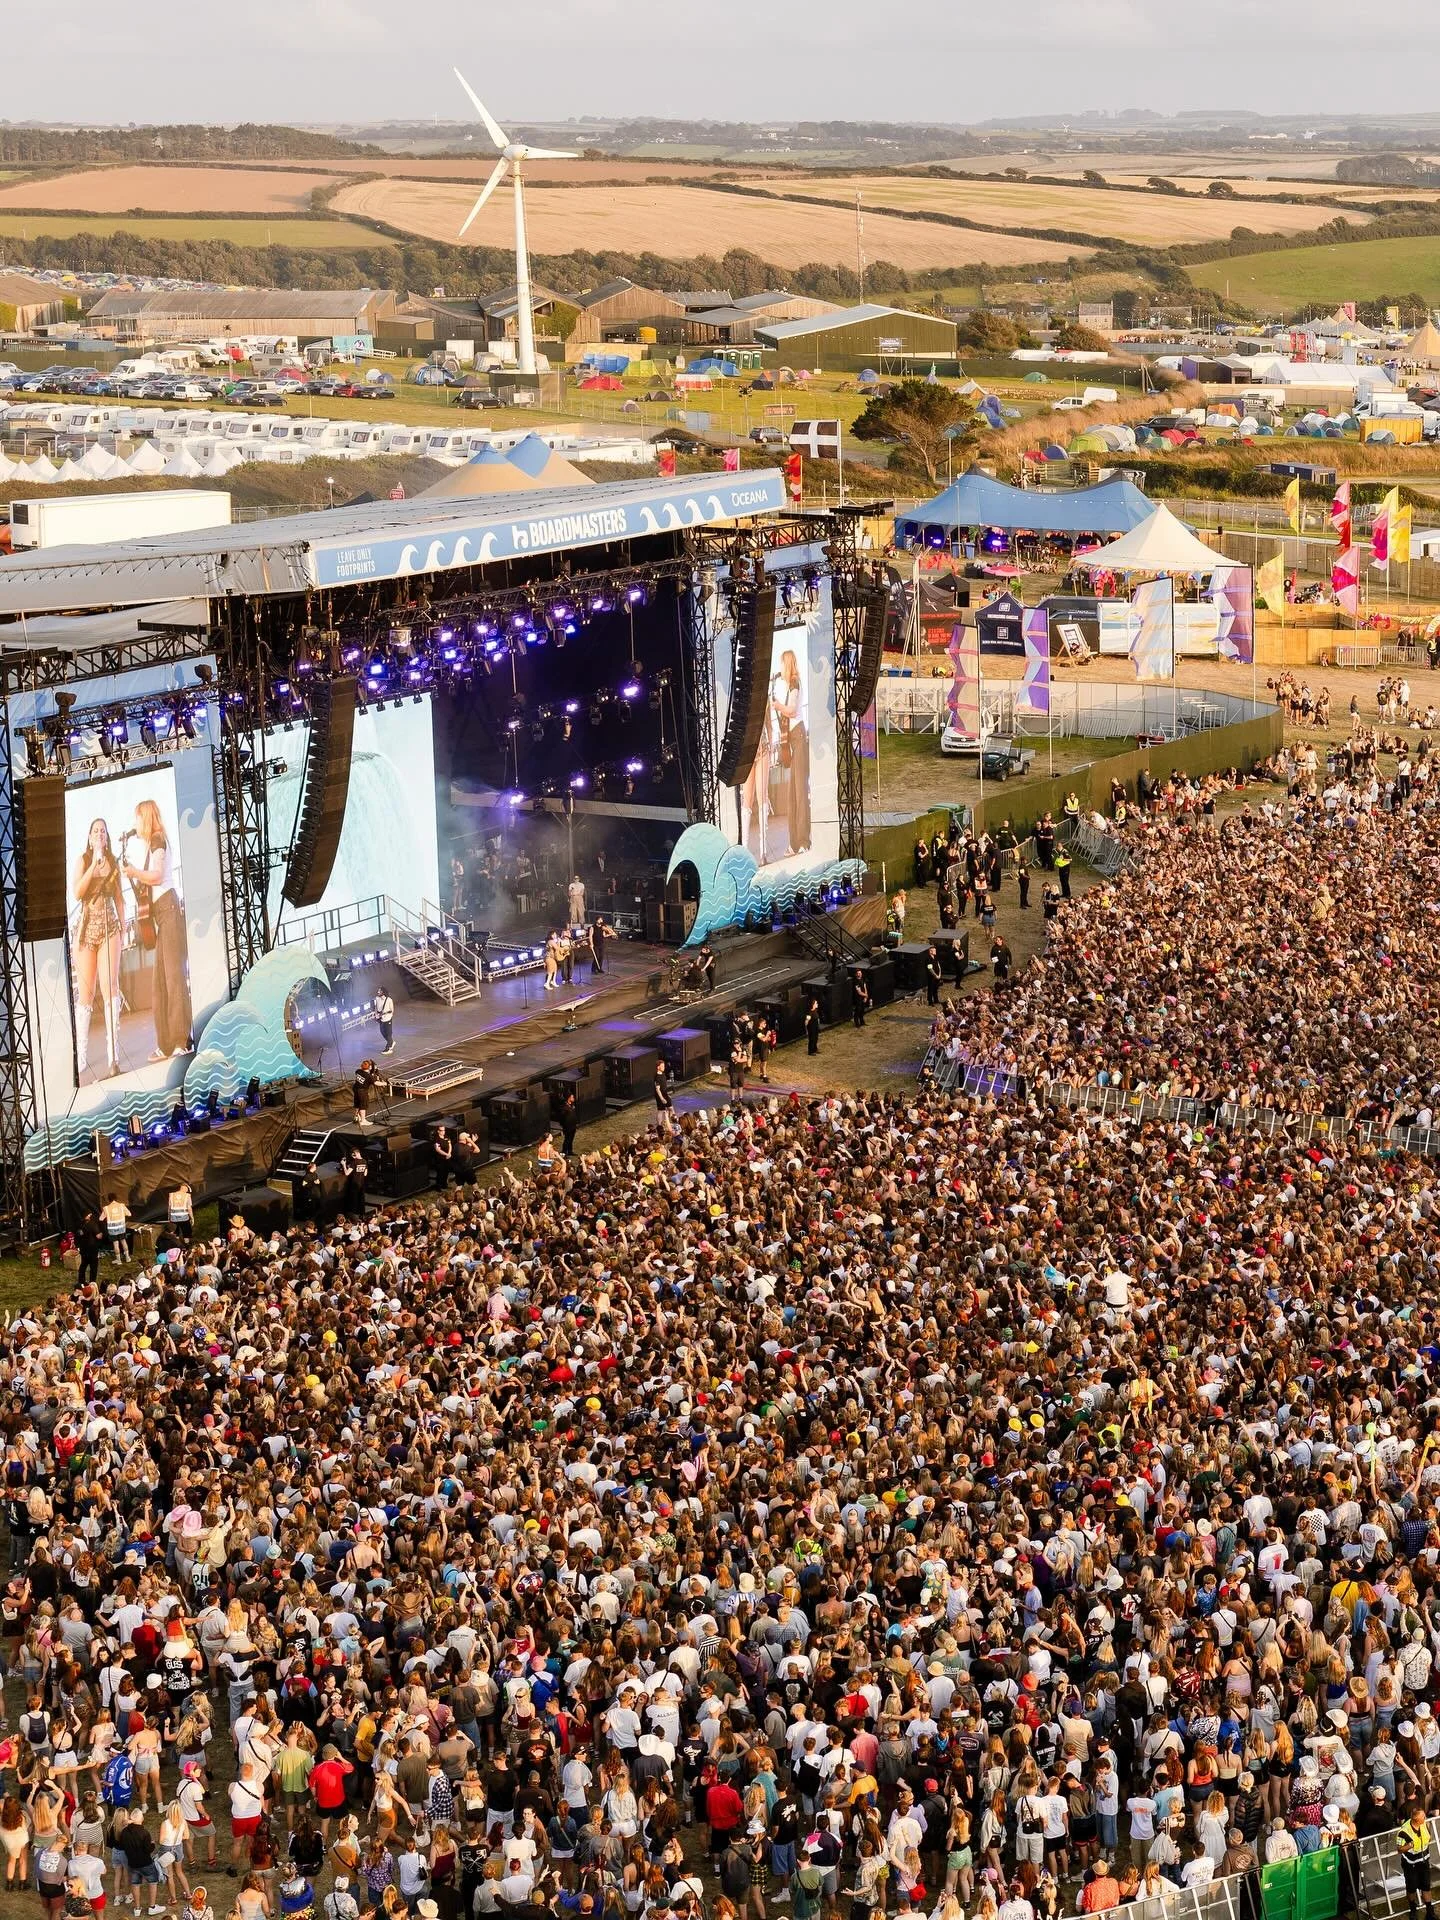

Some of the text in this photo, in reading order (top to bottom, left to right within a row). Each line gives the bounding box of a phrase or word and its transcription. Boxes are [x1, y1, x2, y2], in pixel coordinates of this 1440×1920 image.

[530, 509, 627, 547] BOARDMASTERS
[337, 547, 373, 563] LEAVE ONLY
[337, 560, 375, 576] FOOTPRINTS
[193, 1574, 208, 1588] 24
